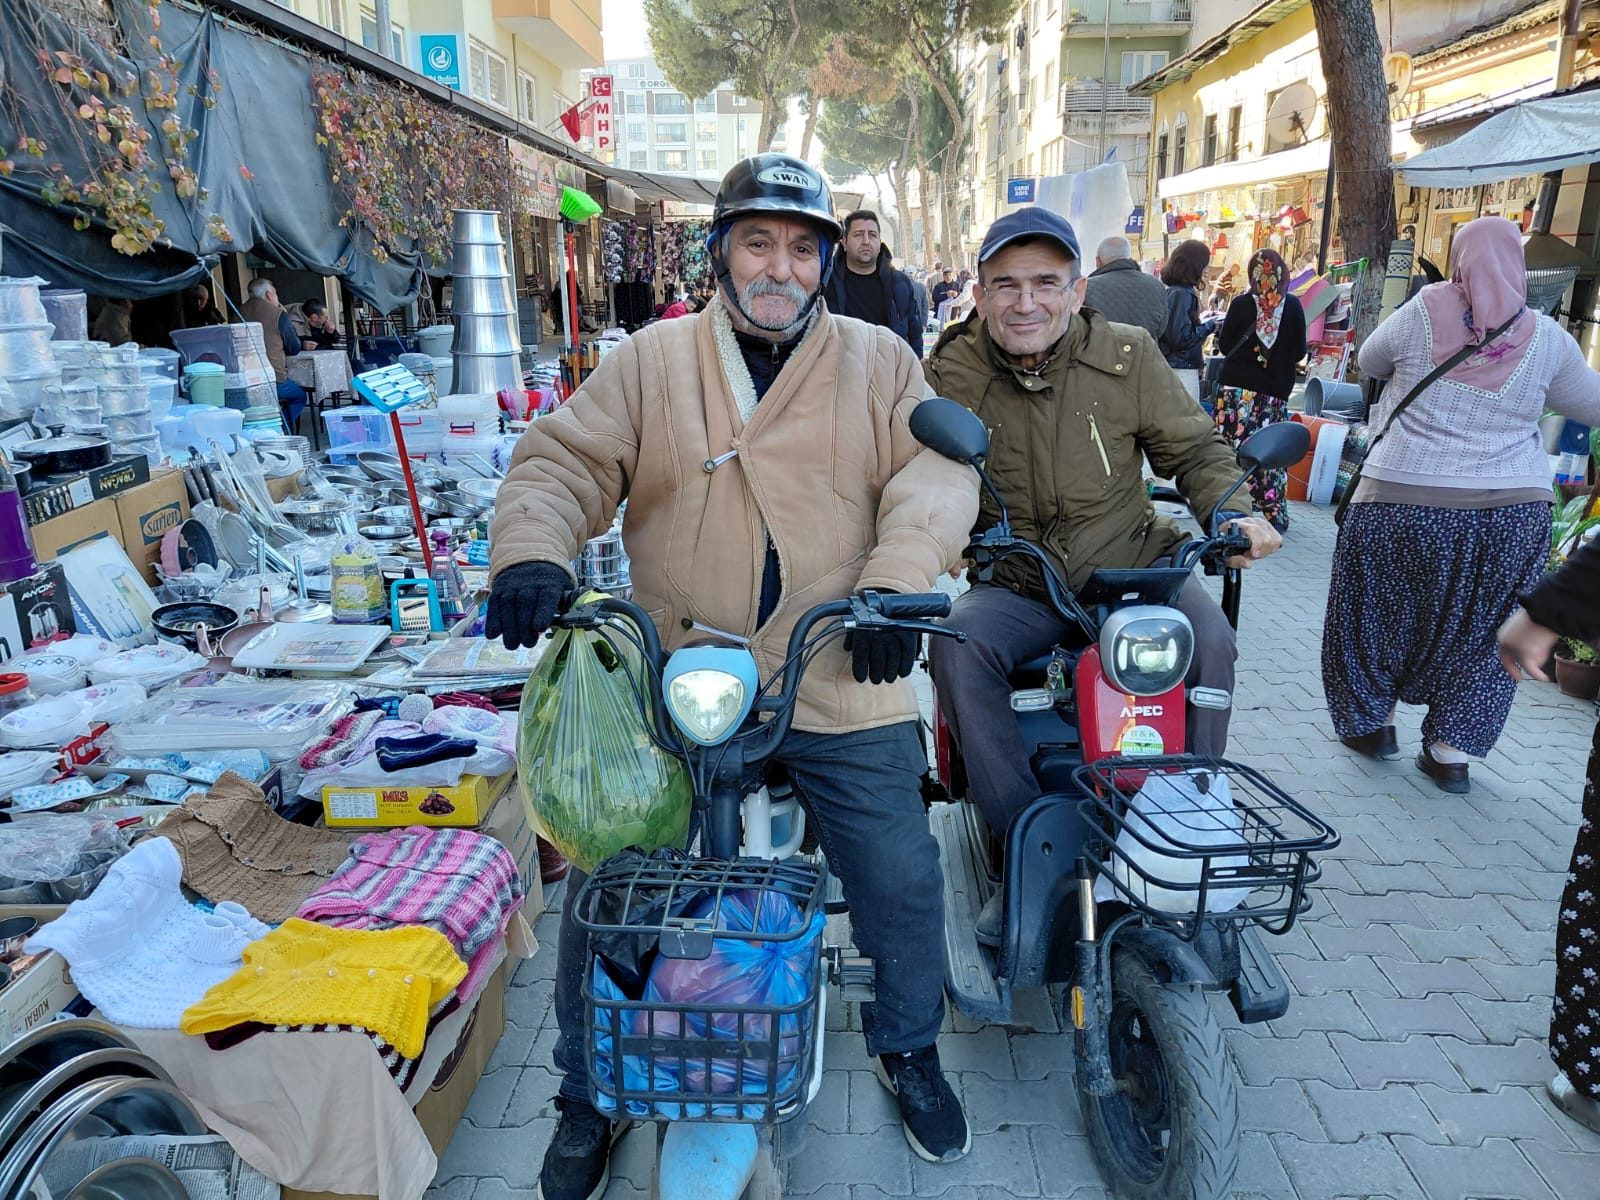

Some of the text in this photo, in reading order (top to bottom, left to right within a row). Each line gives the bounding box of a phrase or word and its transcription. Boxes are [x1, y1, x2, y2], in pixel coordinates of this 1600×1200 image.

[596, 103, 609, 149] MHP
[773, 173, 809, 187] SWAN
[1129, 215, 1144, 226] FE
[147, 510, 178, 536] sarten
[21, 582, 55, 601] AWOX
[1120, 705, 1163, 718] APEC
